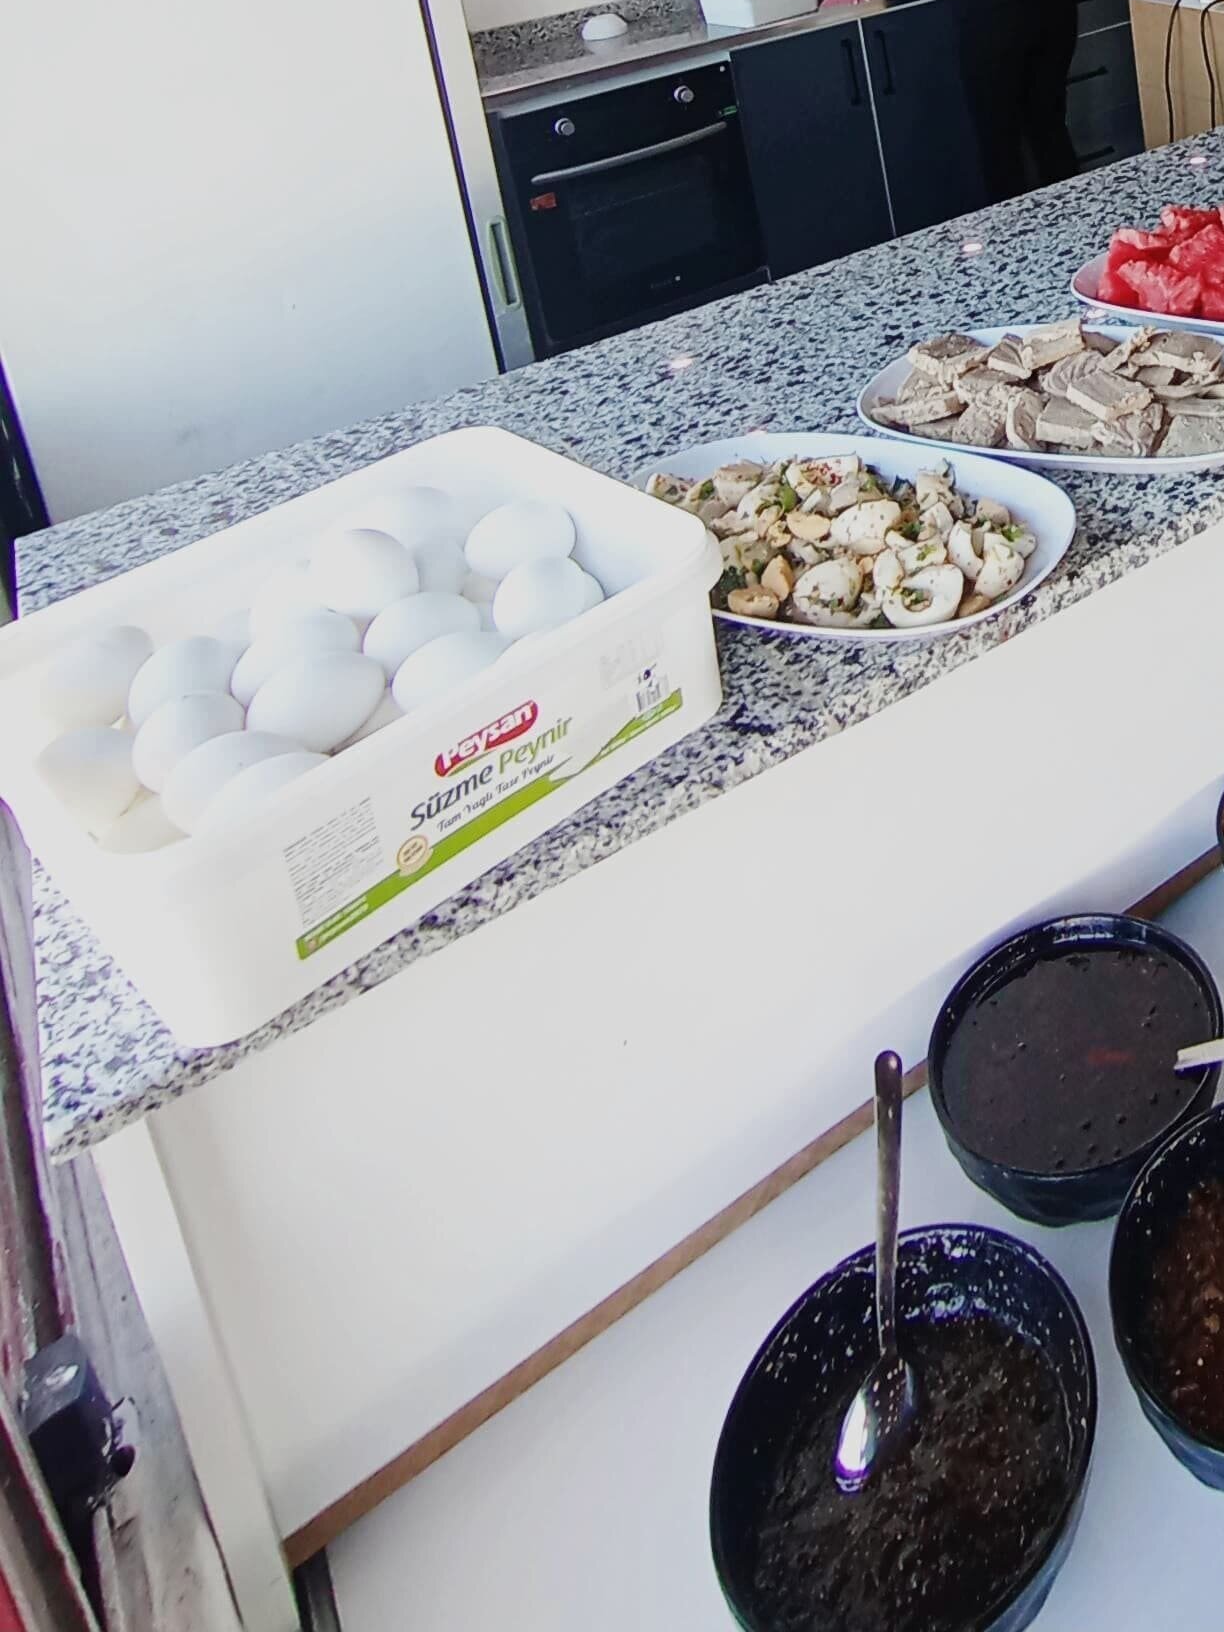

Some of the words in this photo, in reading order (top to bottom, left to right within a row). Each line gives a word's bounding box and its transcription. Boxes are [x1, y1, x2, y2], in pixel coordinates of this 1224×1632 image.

[411, 764, 494, 831] Süzme
[499, 717, 572, 774] Peynir
[440, 703, 536, 770] Peysan
